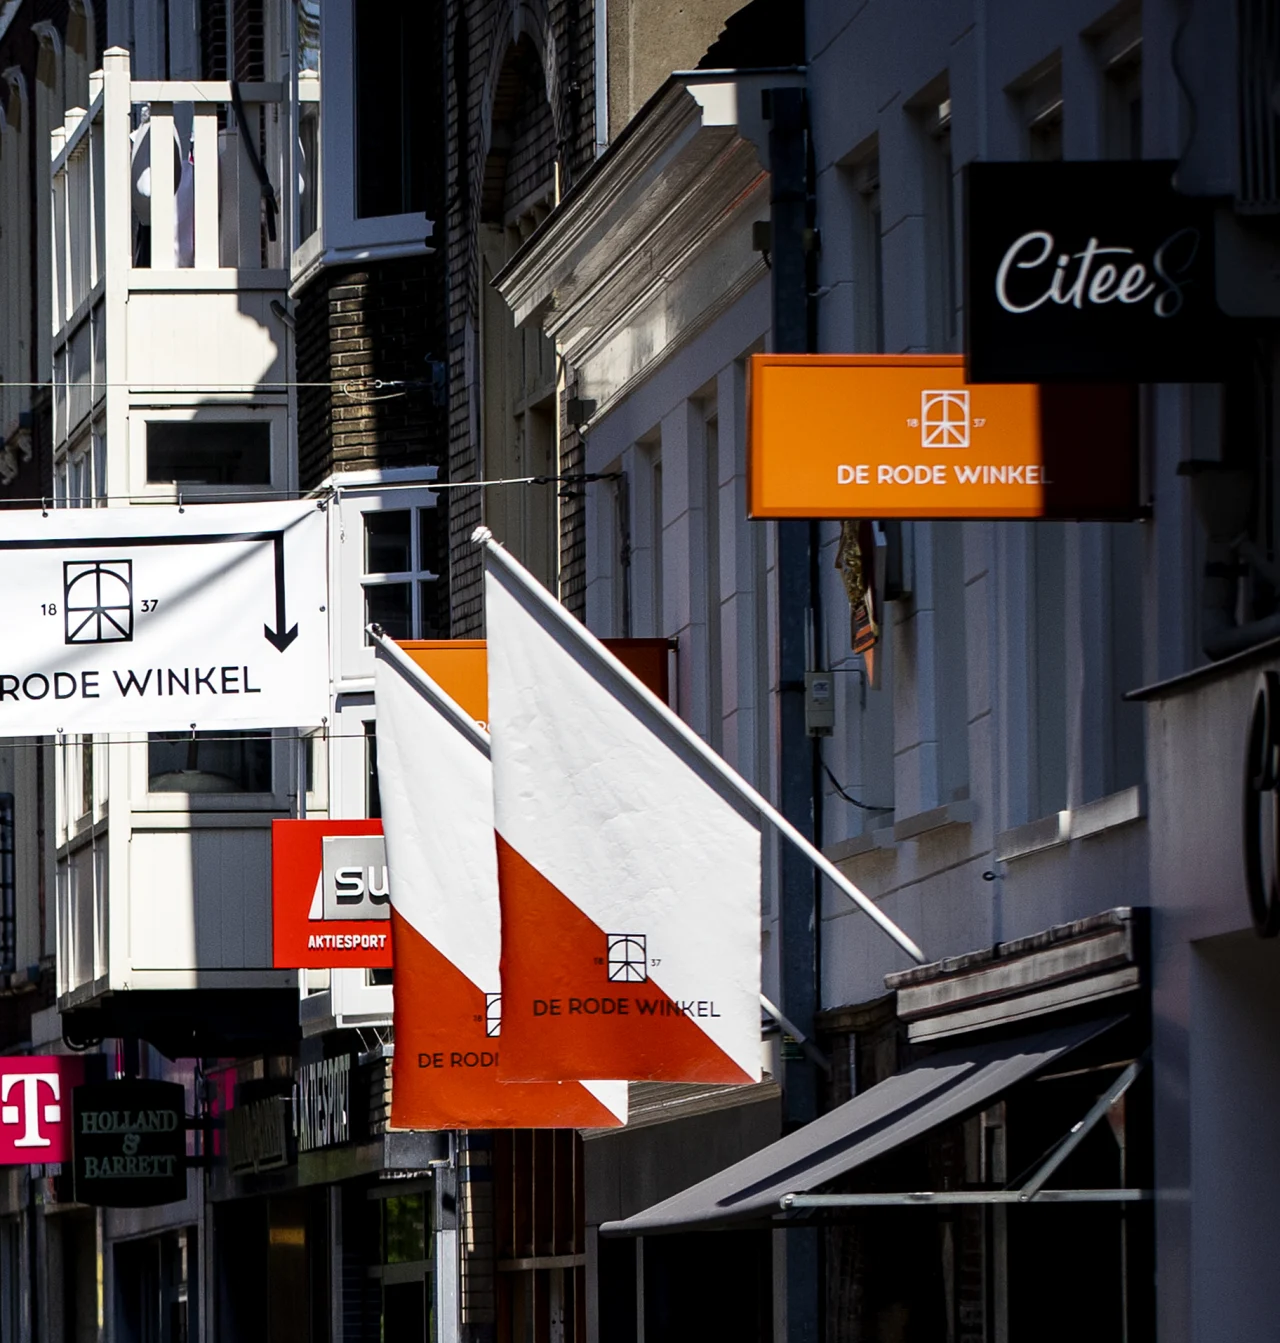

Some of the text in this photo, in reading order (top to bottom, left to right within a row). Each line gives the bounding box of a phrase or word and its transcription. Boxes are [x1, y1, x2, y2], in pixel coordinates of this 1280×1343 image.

[837, 464, 1054, 485] DE RODE WINKEL
[40, 599, 159, 617] 18 37
[112, 665, 261, 698] WINKEL
[308, 934, 387, 950] AKTIESPORT
[651, 958, 662, 967] 37
[533, 997, 722, 1018] DE RODE WINKEL
[418, 1053, 444, 1069] DE
[81, 1110, 178, 1133] HOLLAND
[122, 1135, 141, 1155] &
[83, 1156, 178, 1179] BARRETT
